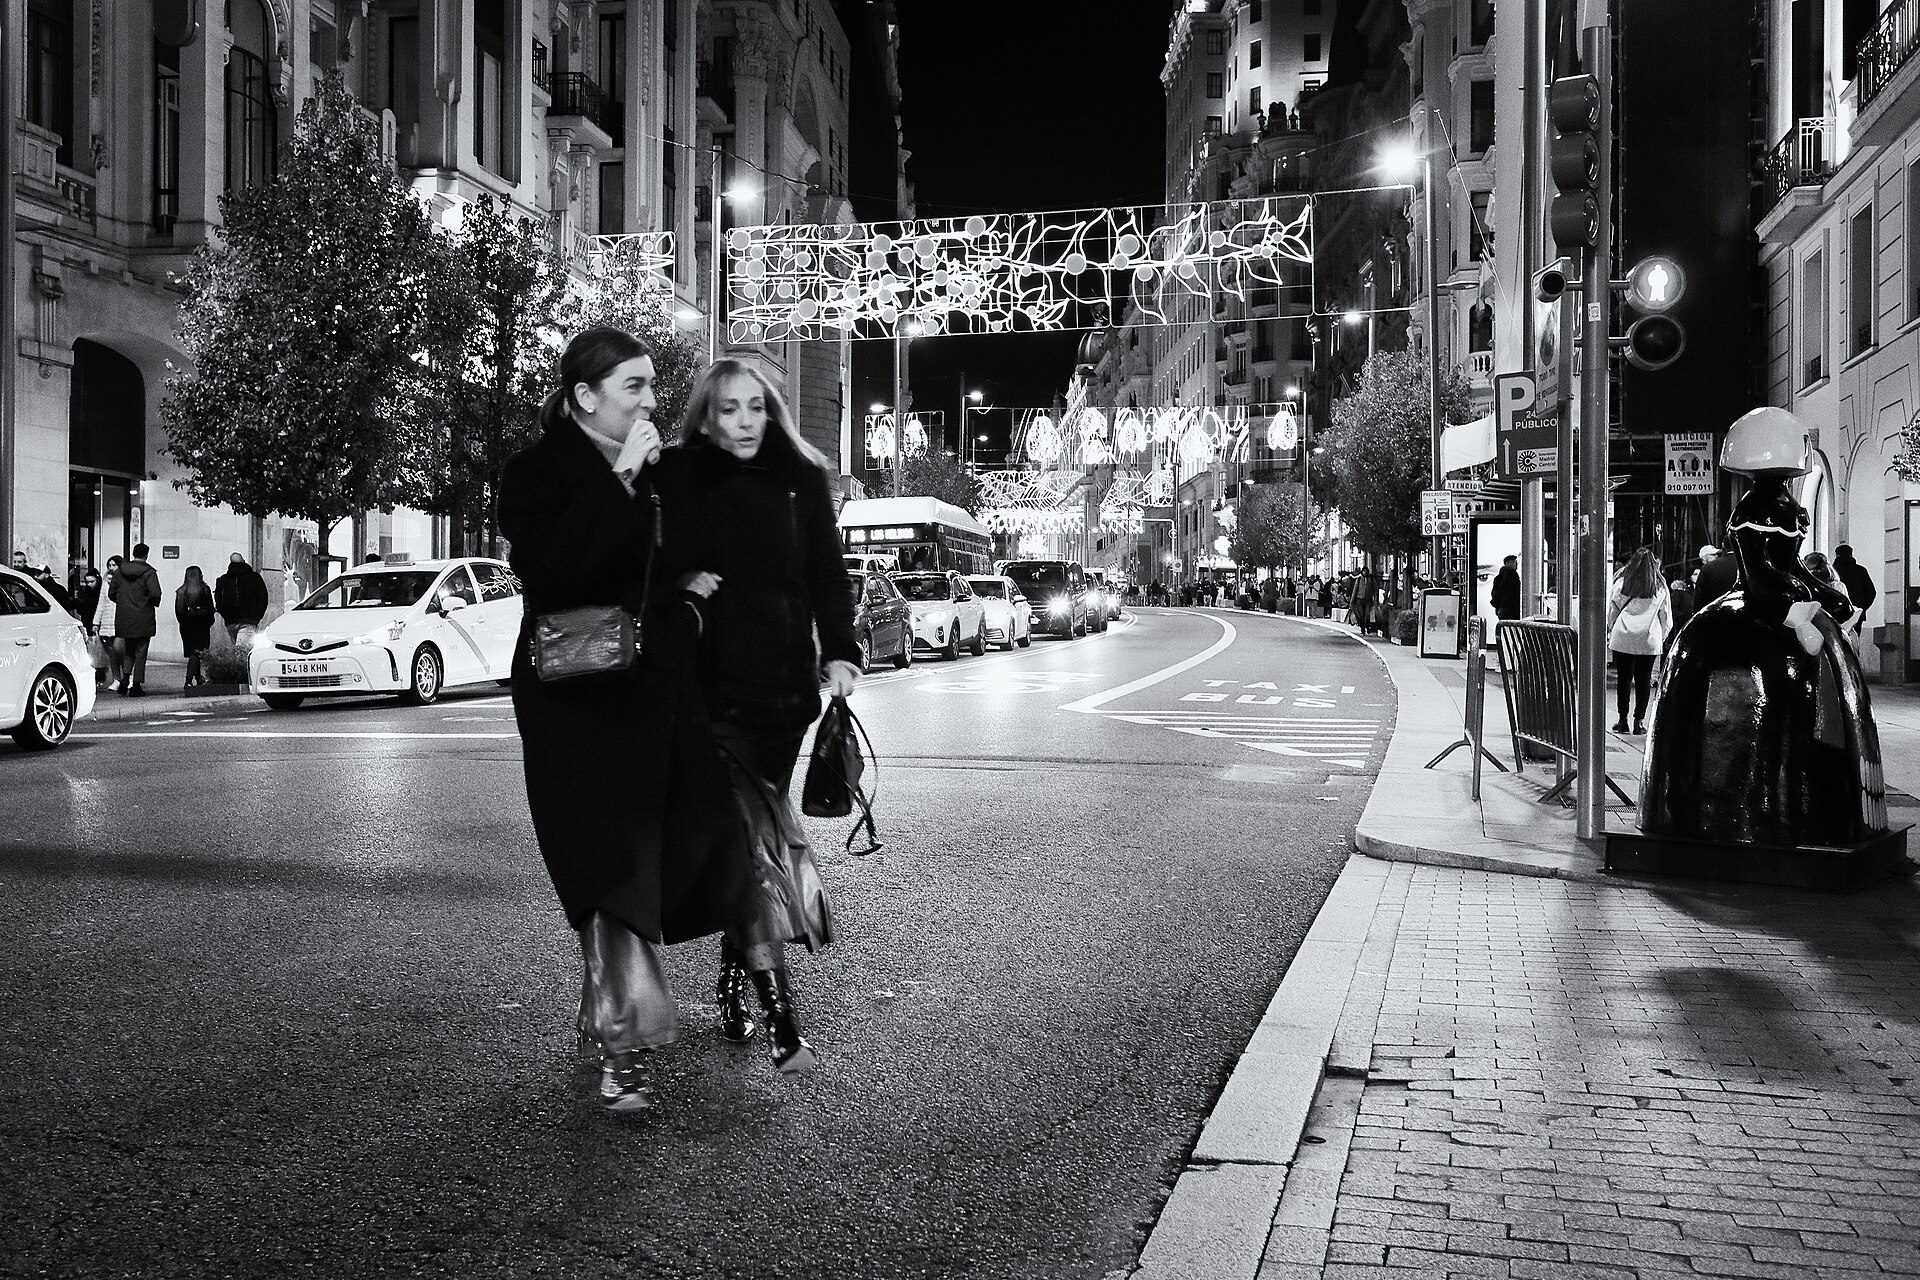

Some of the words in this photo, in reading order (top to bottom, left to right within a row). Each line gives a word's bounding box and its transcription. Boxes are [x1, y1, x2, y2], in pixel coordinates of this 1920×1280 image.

[1500, 377, 1535, 431] P
[1515, 419, 1557, 429] PÚBLICO
[287, 664, 309, 674] 5418
[310, 663, 328, 673] KHN
[1202, 679, 1355, 694] TAXI
[1178, 692, 1337, 708] BUS
